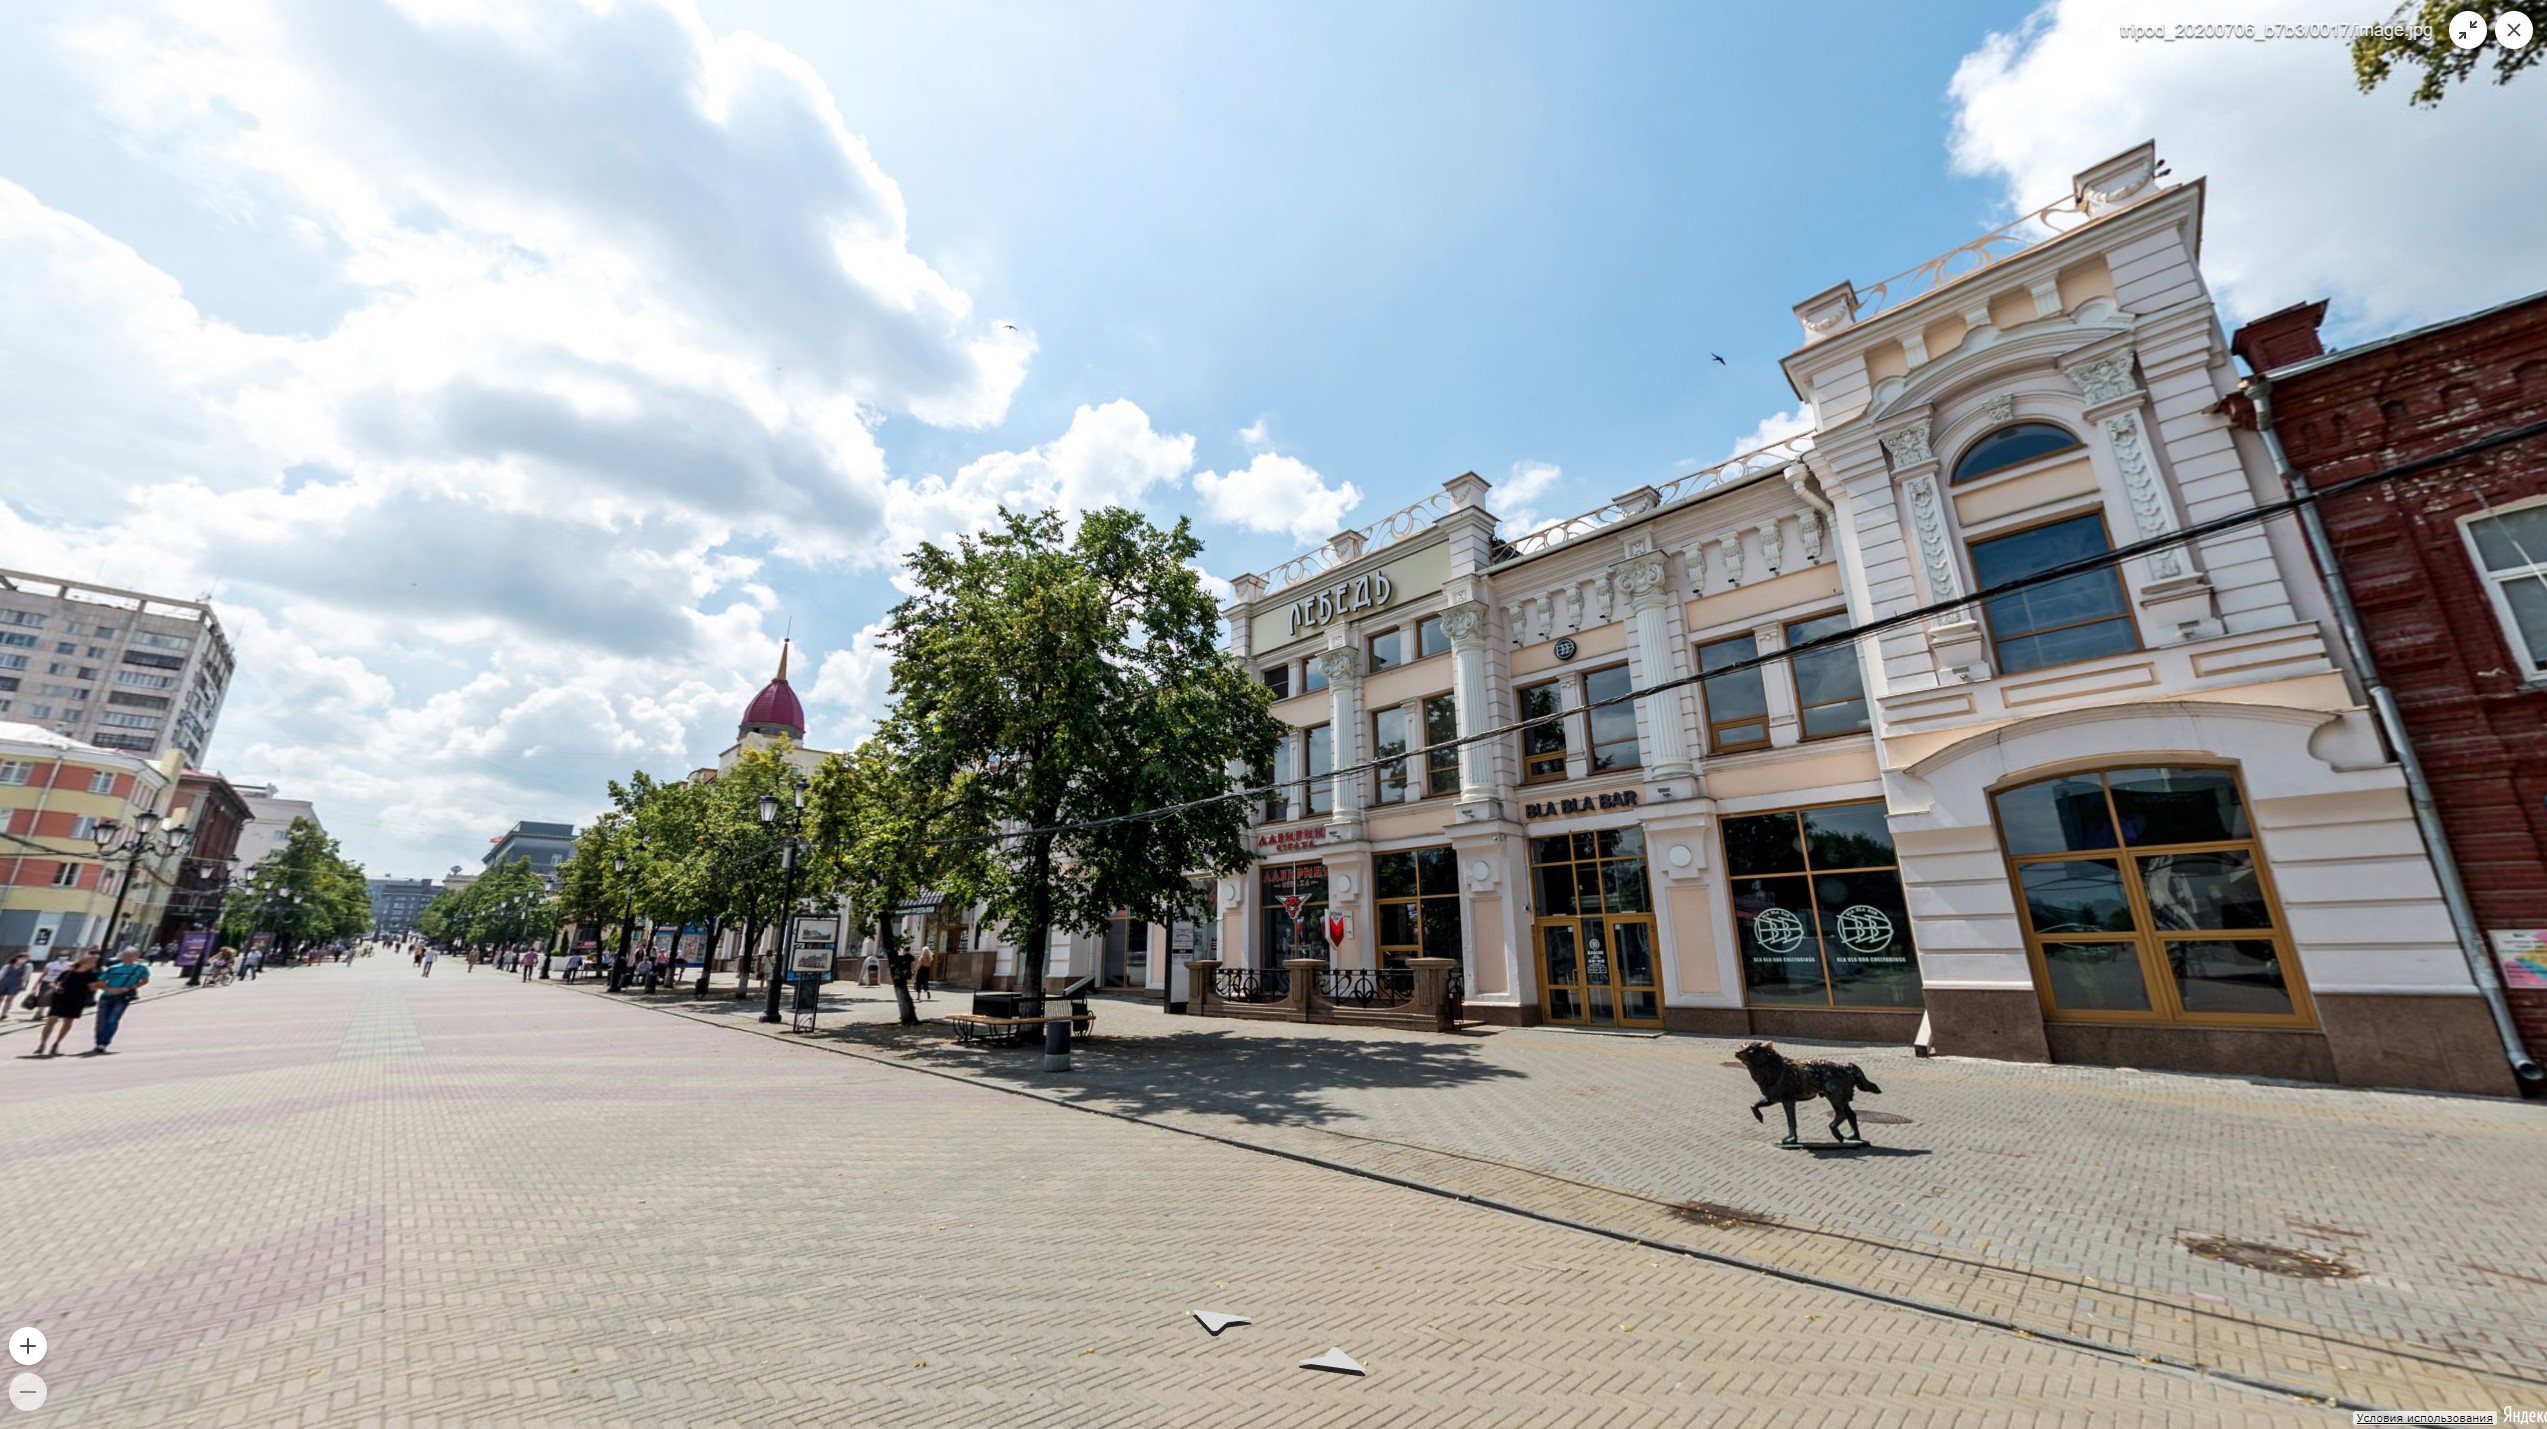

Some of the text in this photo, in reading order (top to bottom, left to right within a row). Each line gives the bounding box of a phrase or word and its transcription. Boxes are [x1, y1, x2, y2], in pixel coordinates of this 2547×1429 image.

[1289, 570, 1392, 636] ЛЕБЕДЬ
[1525, 790, 1638, 819] BLA BLA BAR
[1258, 826, 1326, 847] ЛАБИРИН
